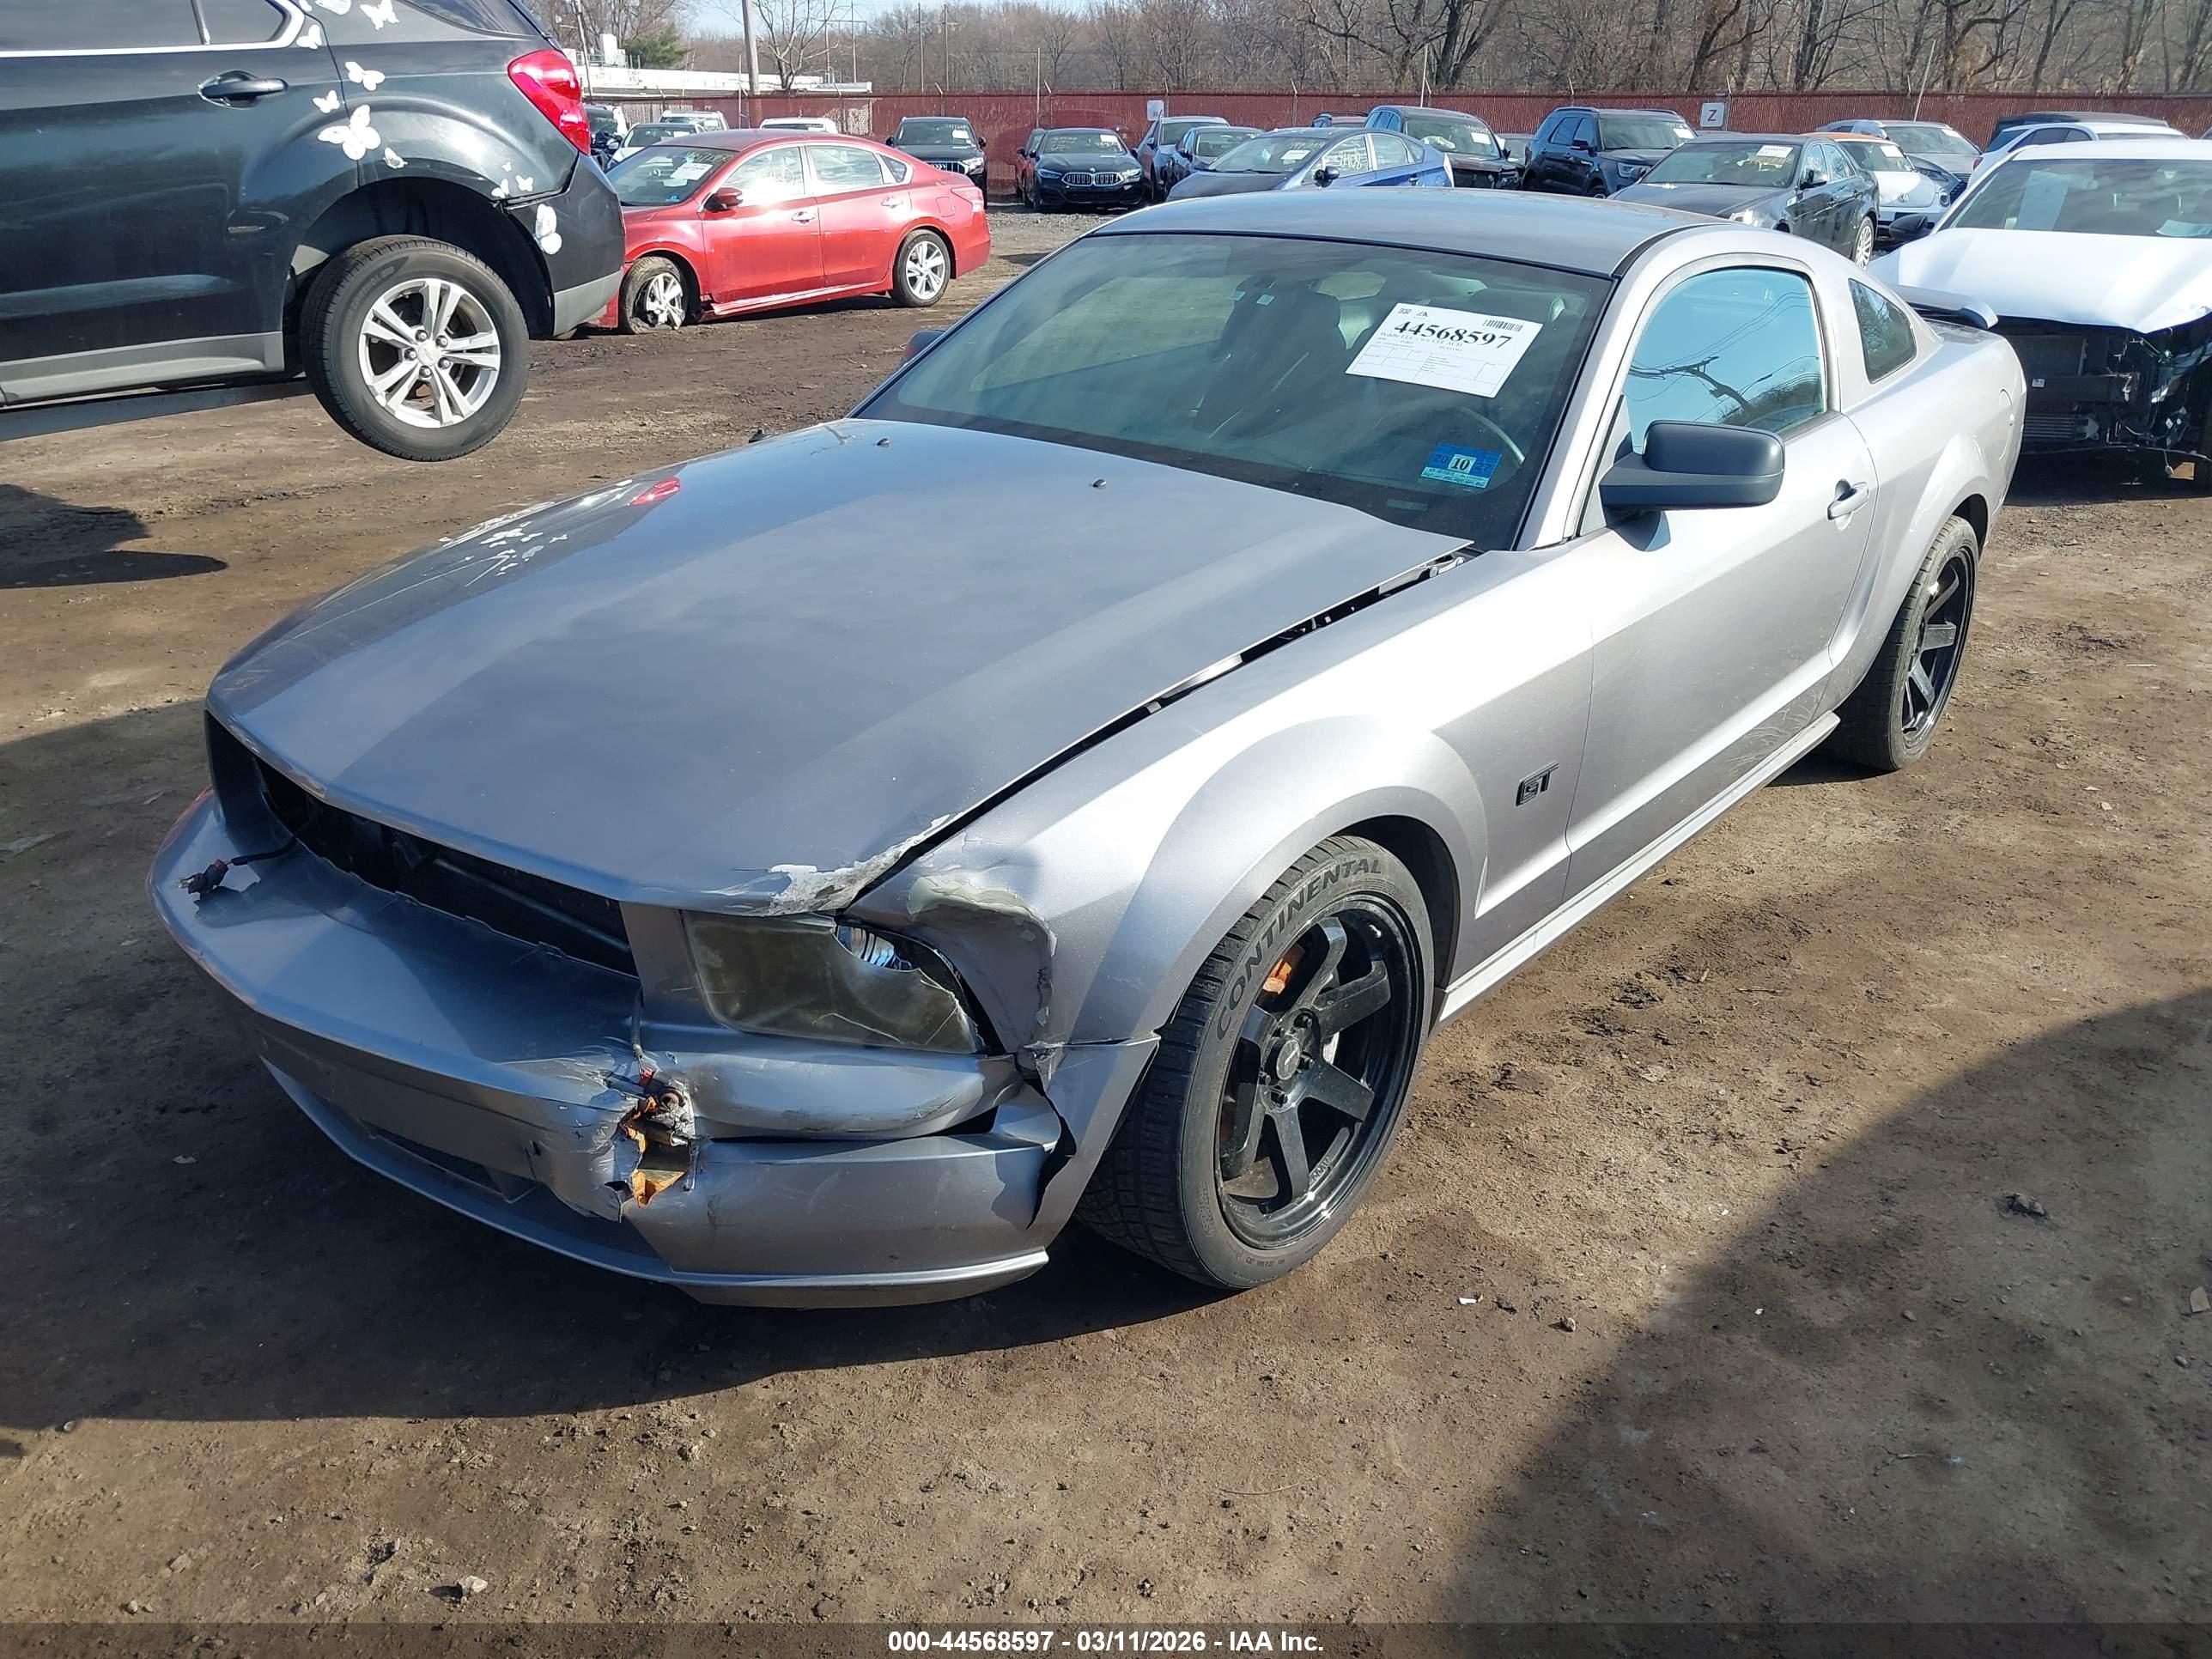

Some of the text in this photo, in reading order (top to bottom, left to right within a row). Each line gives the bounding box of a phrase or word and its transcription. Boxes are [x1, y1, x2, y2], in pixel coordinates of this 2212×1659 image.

[1707, 109, 1717, 122] Z
[1394, 321, 1514, 349] 44568597
[1434, 453, 1449, 464] 20
[1451, 457, 1471, 471] 10
[1516, 761, 1559, 807] GT
[1215, 858, 1382, 1042] CONTINENTAL
